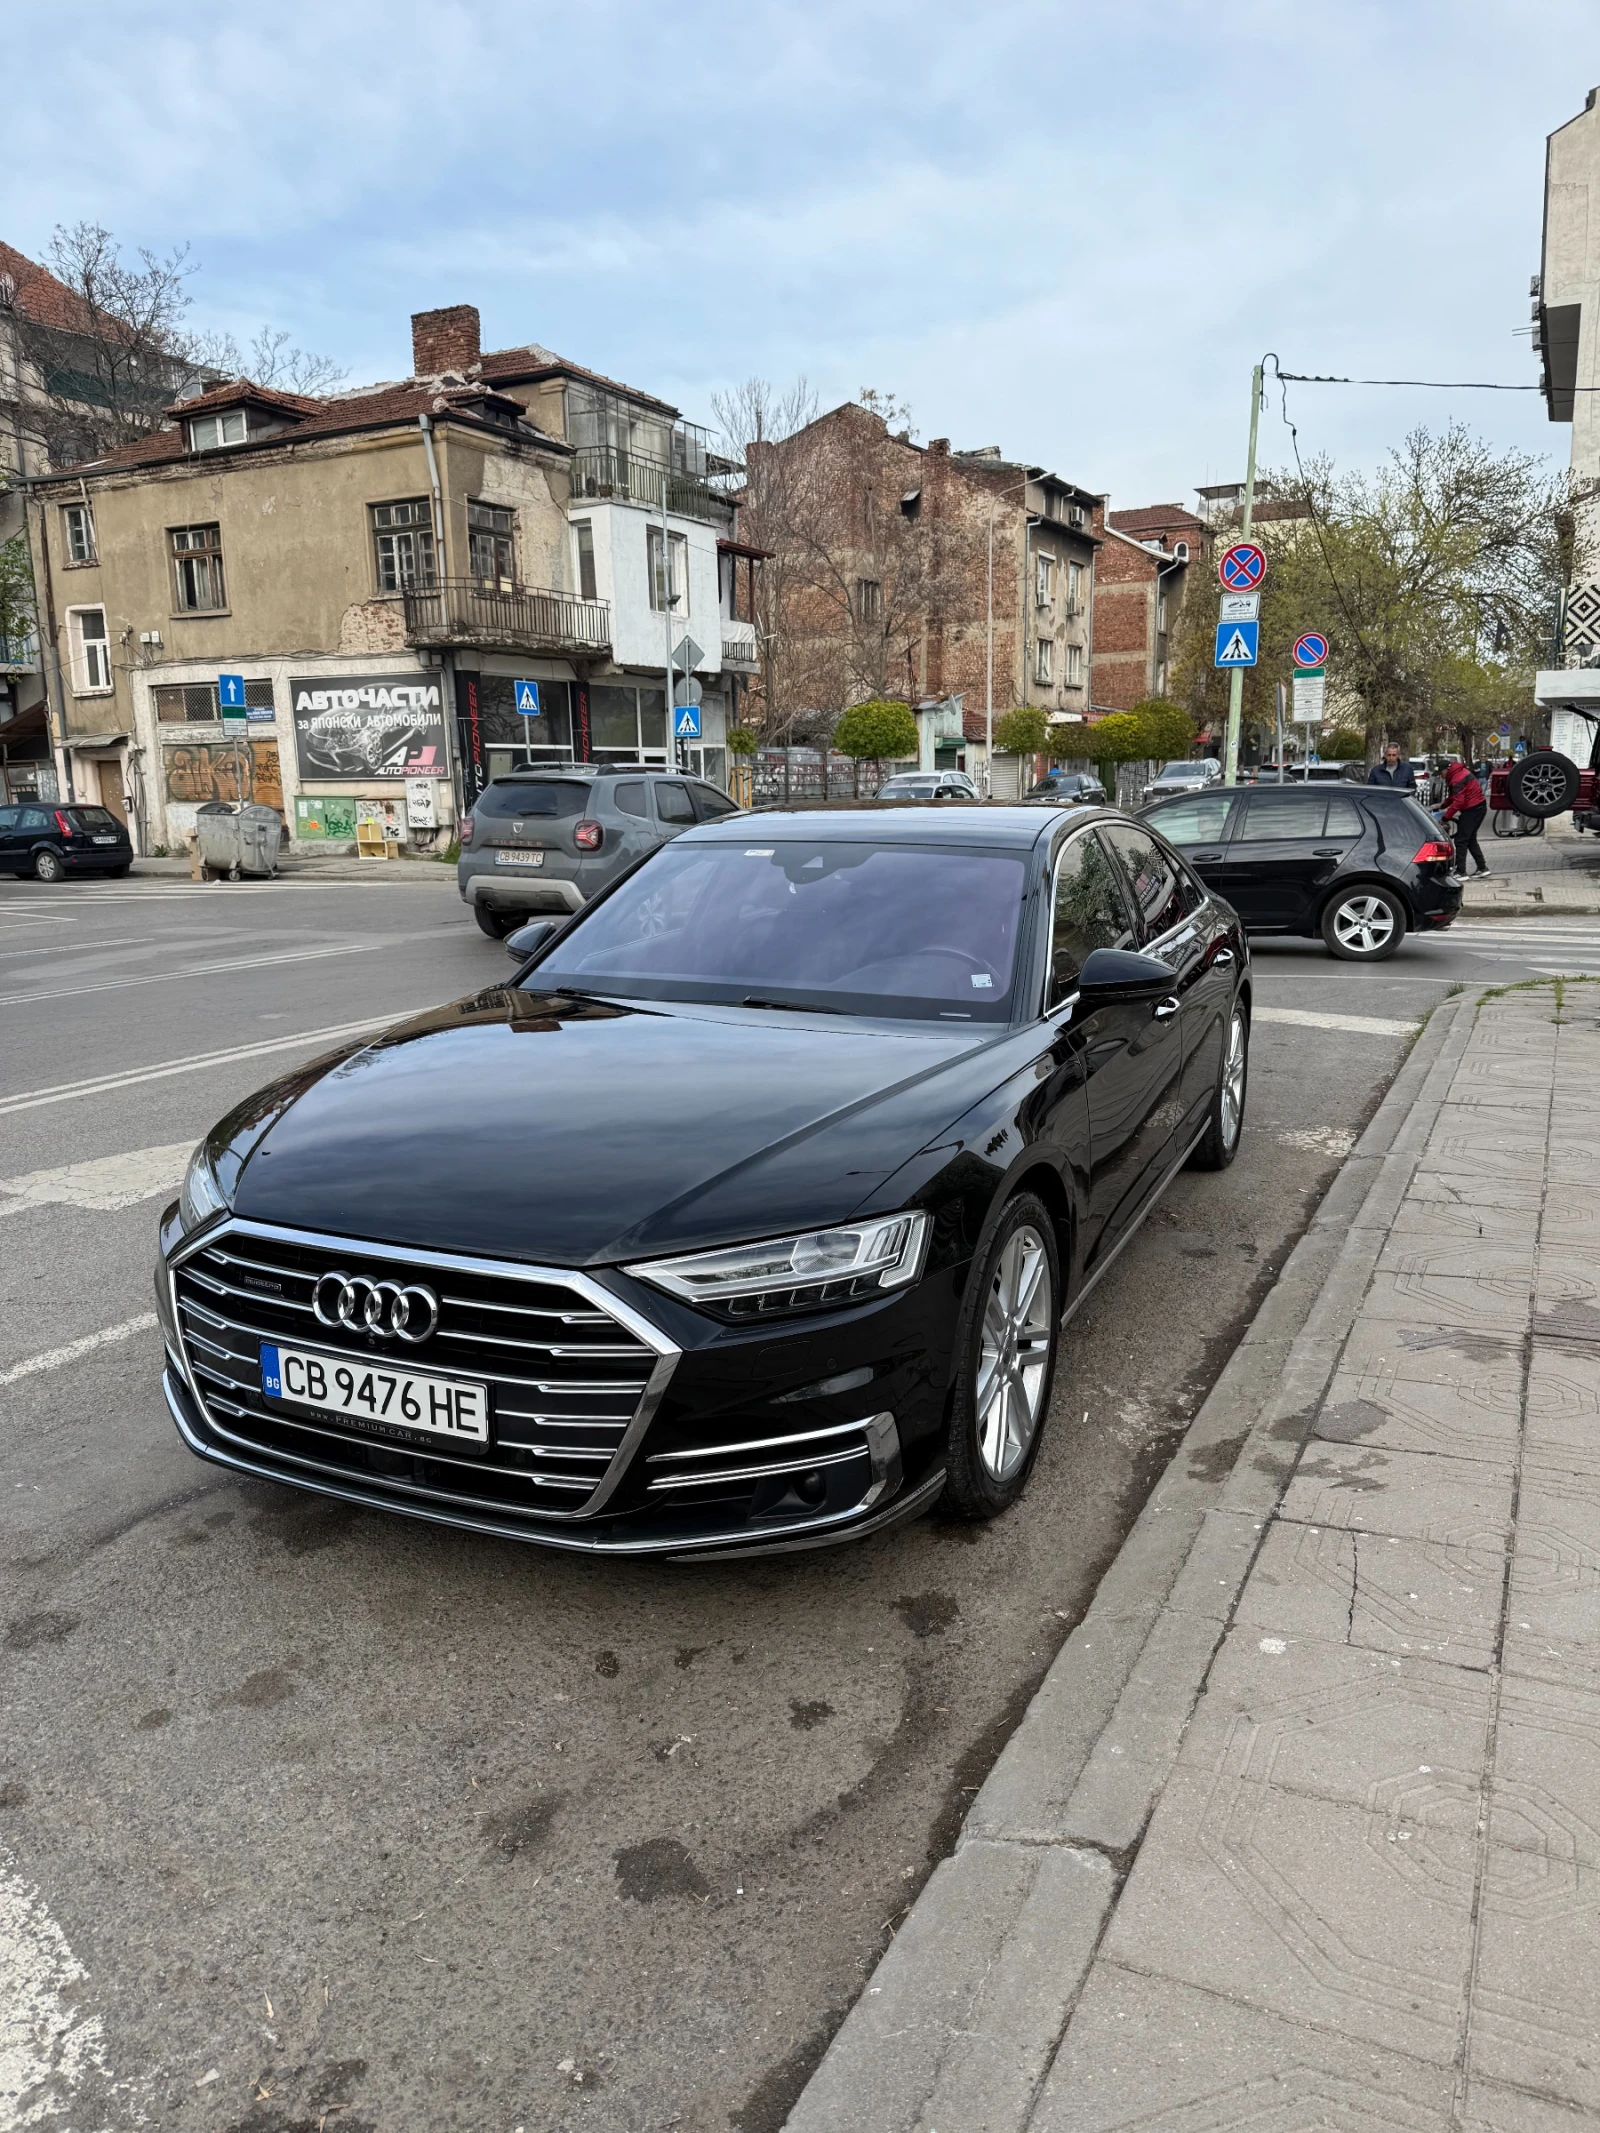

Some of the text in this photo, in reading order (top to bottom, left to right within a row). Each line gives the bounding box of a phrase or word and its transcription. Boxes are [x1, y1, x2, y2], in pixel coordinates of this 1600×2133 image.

[295, 685, 440, 711] АВТОЧАСТИ
[297, 713, 442, 730] за ЯПОНСКИ АВТОМОБИЛИ
[468, 681, 484, 797] TOPIONEER
[374, 766, 446, 775] AUTOPIONEER
[499, 851, 542, 863] CB 9439 TC
[266, 1376, 280, 1389] BG
[283, 1356, 480, 1434] CB 9476 HE
